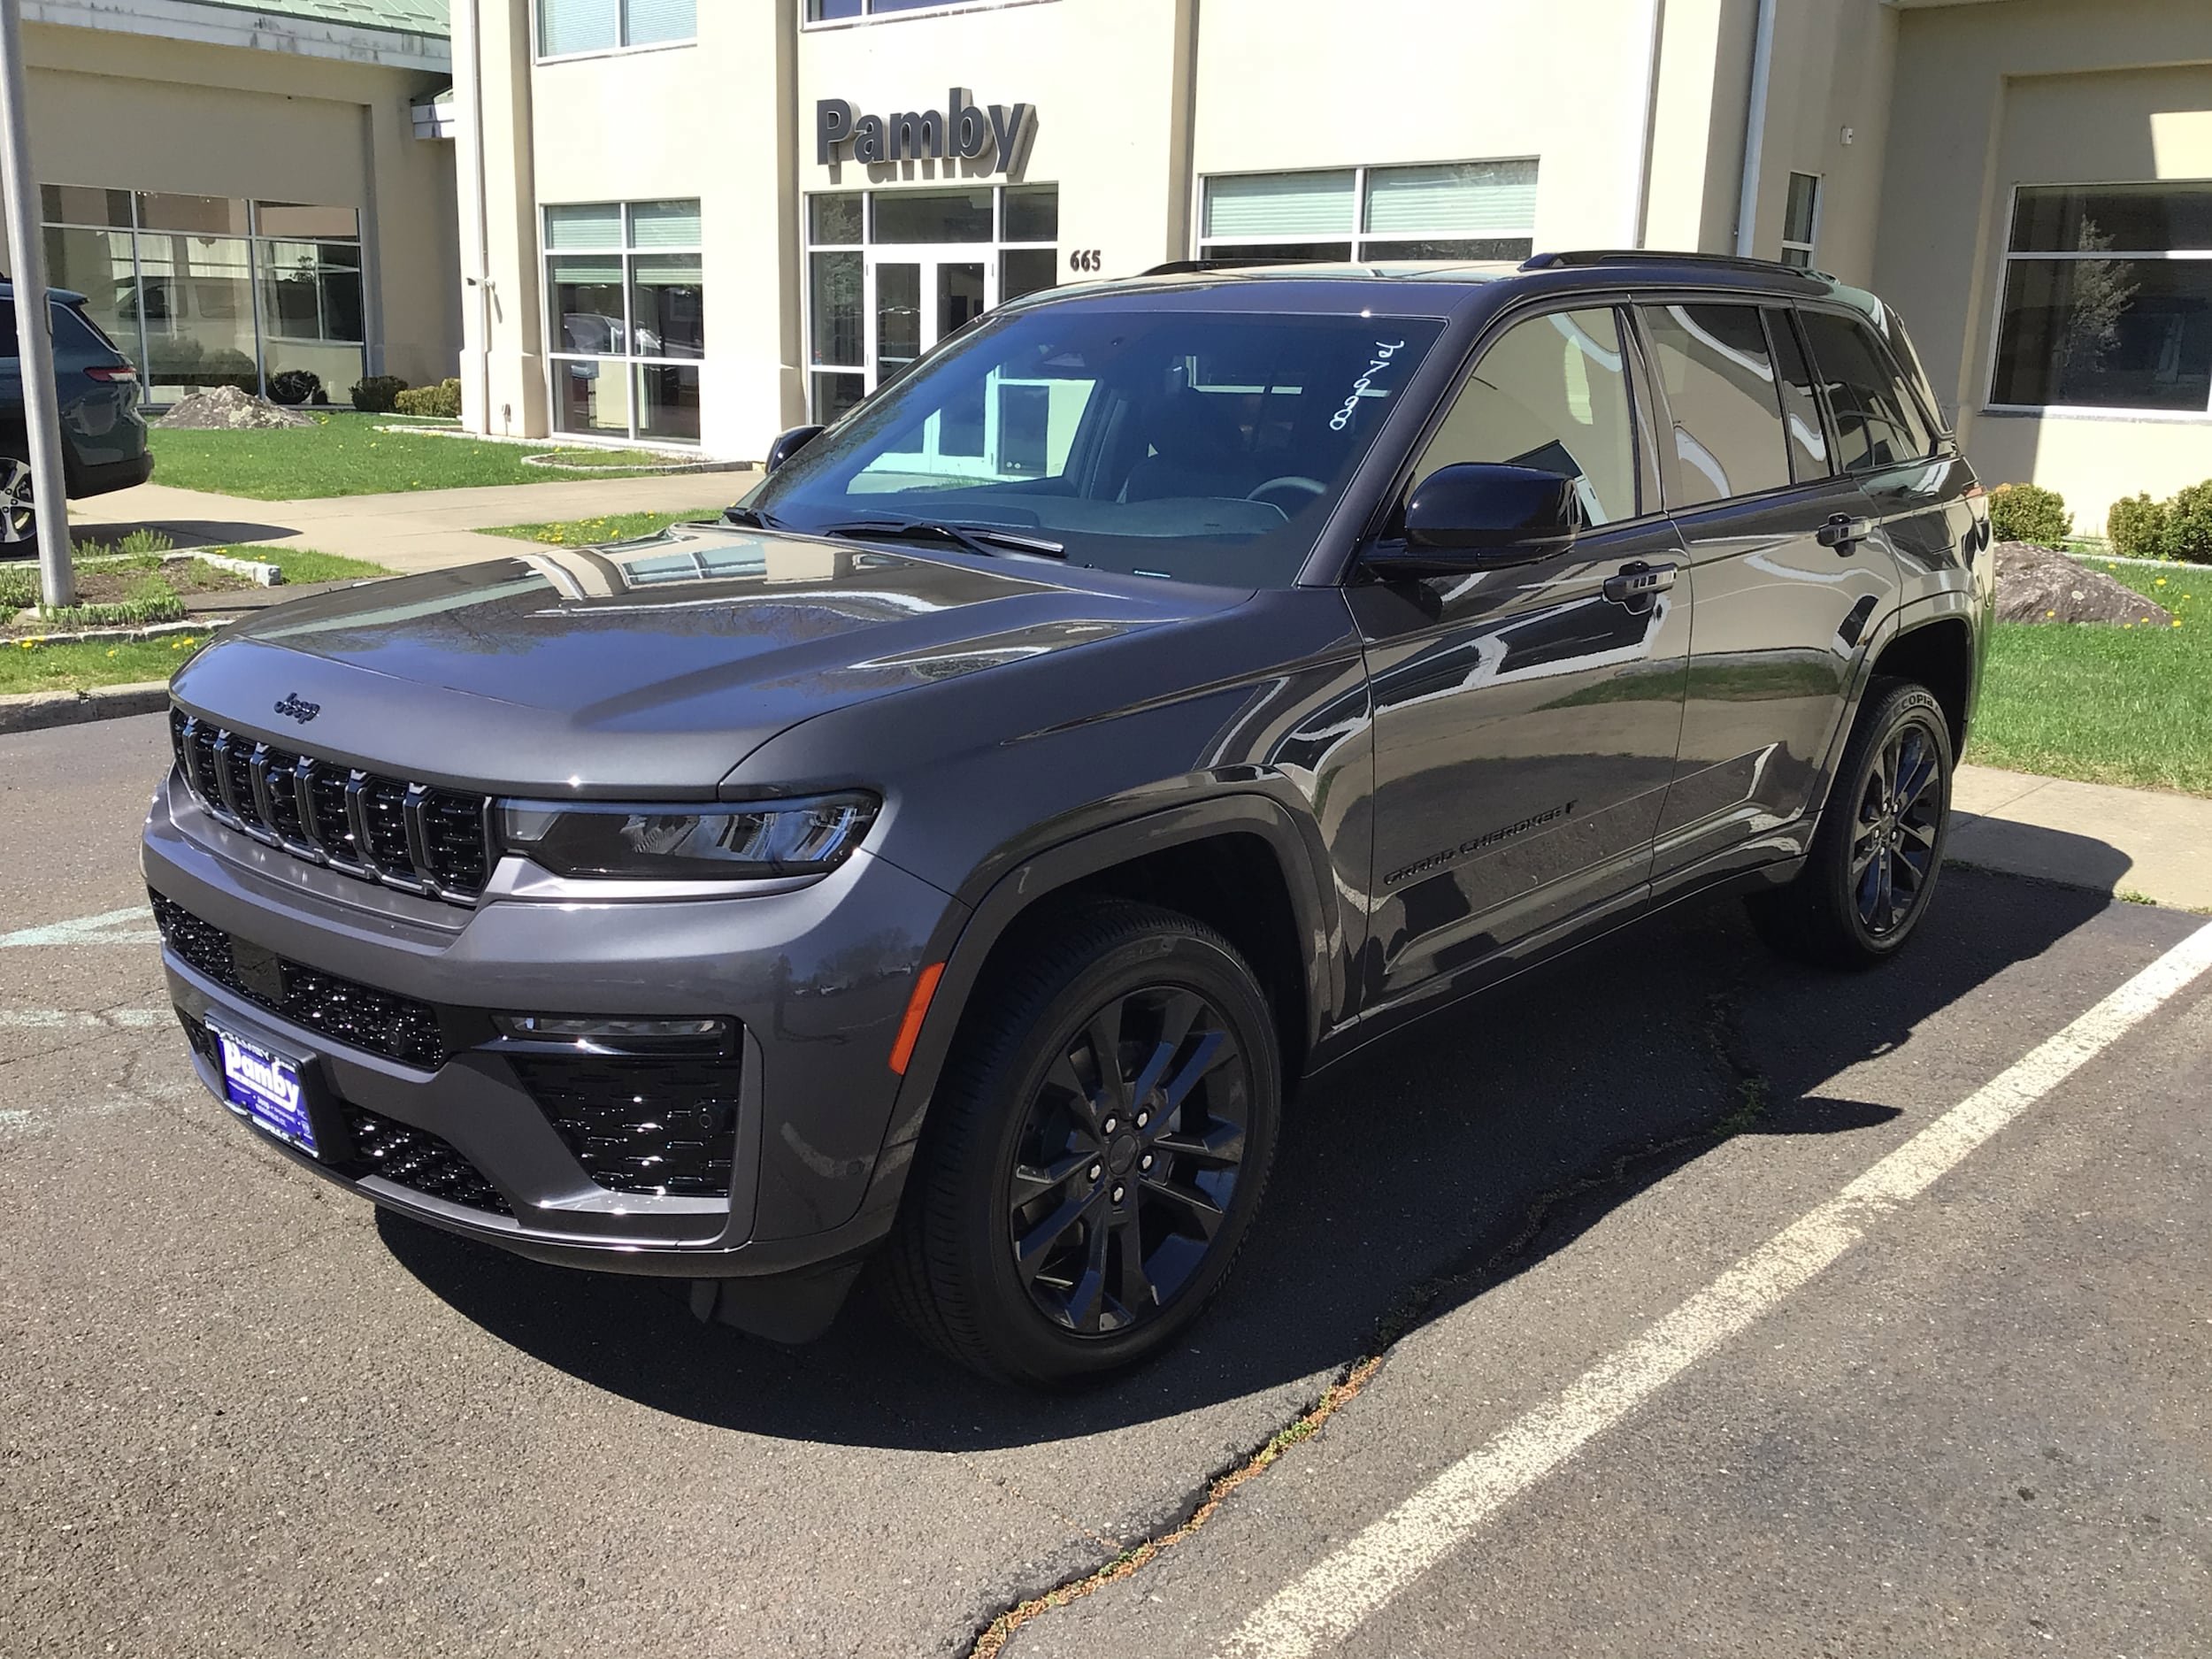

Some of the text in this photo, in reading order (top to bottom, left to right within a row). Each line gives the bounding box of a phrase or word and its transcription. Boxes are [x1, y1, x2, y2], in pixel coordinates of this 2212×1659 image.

[817, 87, 1035, 174] Pamby
[1070, 250, 1101, 271] 665
[273, 692, 320, 725] Jeep
[1384, 805, 1563, 885] GRAND CHEROKEE
[222, 1038, 300, 1112] Pamby
